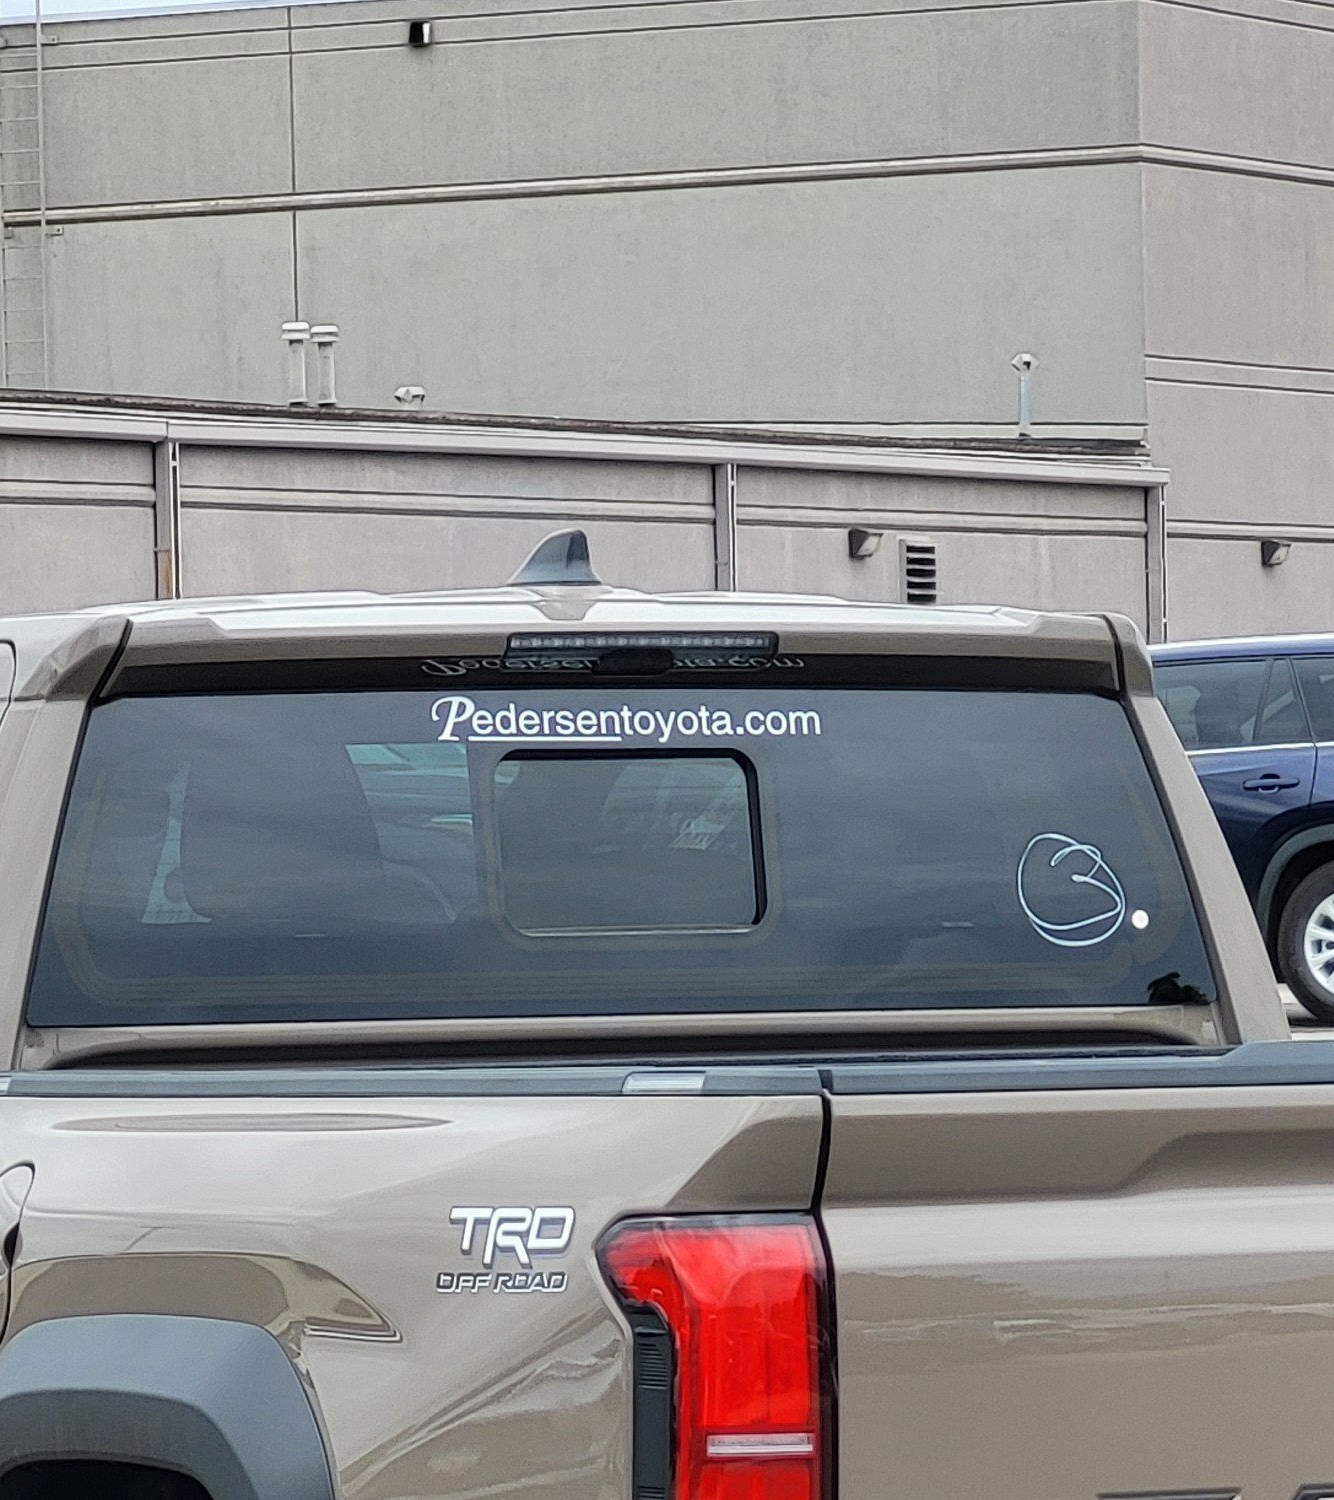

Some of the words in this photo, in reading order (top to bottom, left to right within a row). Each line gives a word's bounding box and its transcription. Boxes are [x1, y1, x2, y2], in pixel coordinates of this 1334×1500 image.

[430, 695, 822, 742] Pedersentoyota.com
[449, 1206, 576, 1269] TRD
[436, 1272, 492, 1294] OFF
[492, 1272, 568, 1294] ROAD
